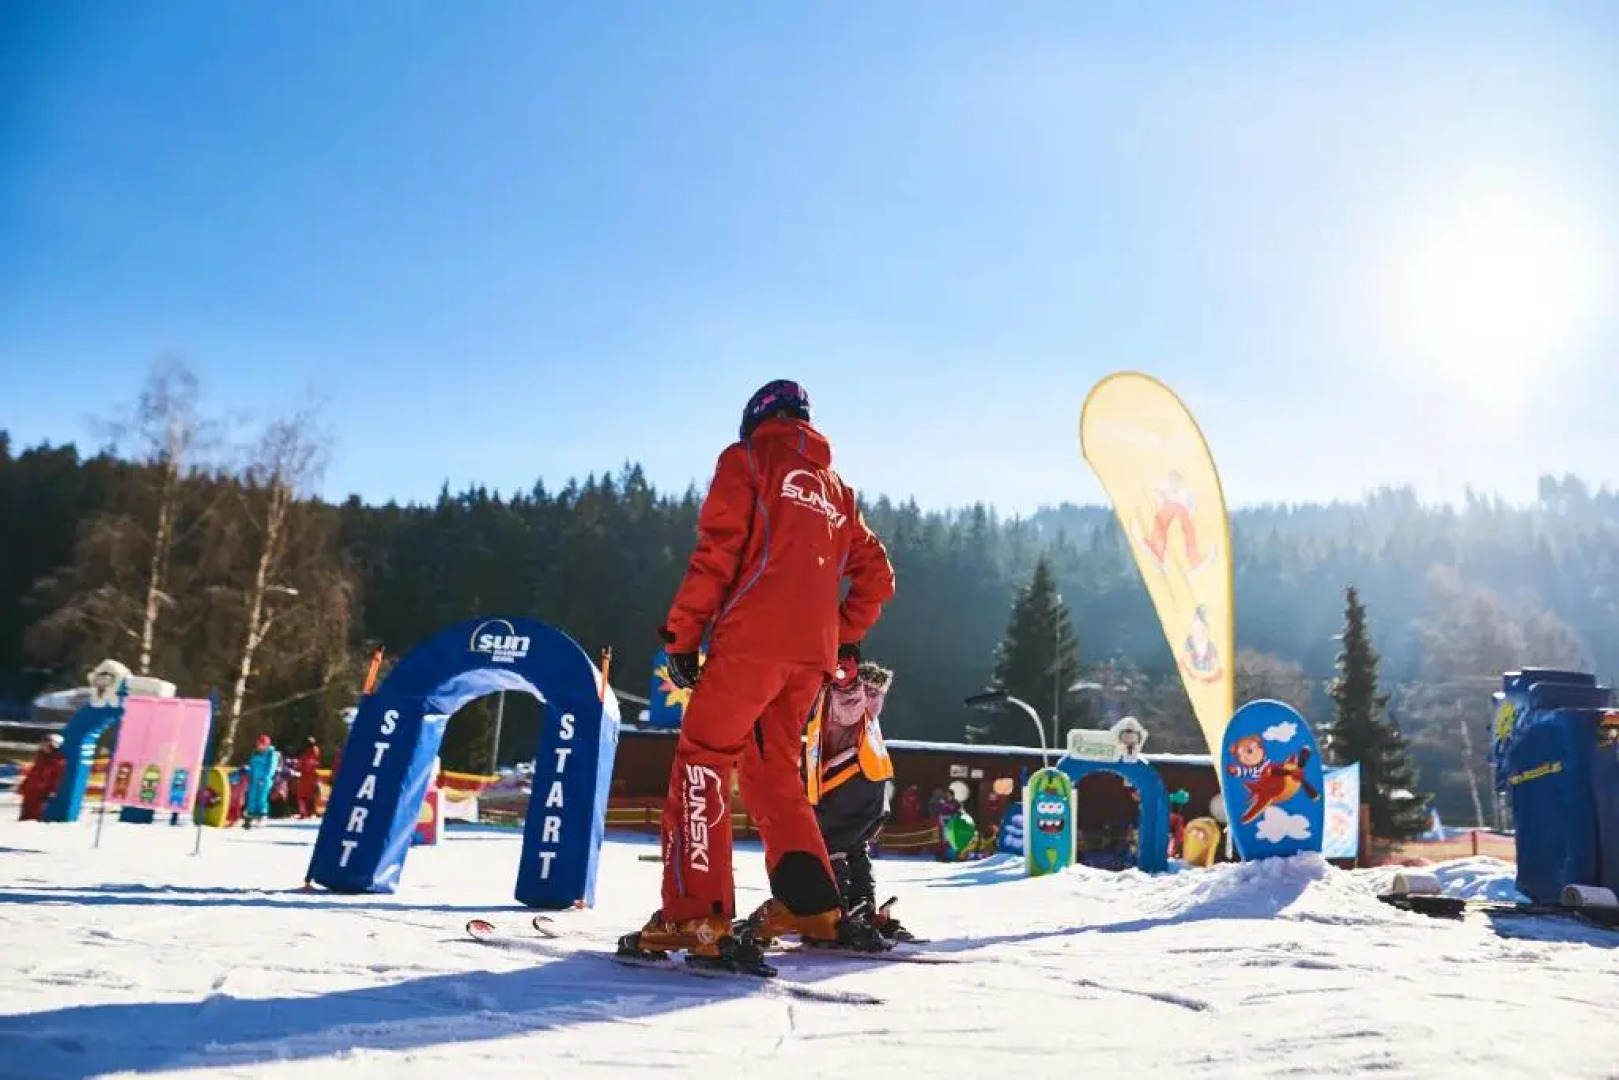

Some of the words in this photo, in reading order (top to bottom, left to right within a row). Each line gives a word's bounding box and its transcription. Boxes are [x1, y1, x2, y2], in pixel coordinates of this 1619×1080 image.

[479, 634, 530, 651] sun
[339, 709, 400, 867] START
[538, 713, 576, 880] START
[685, 763, 709, 872] SUNSKI
